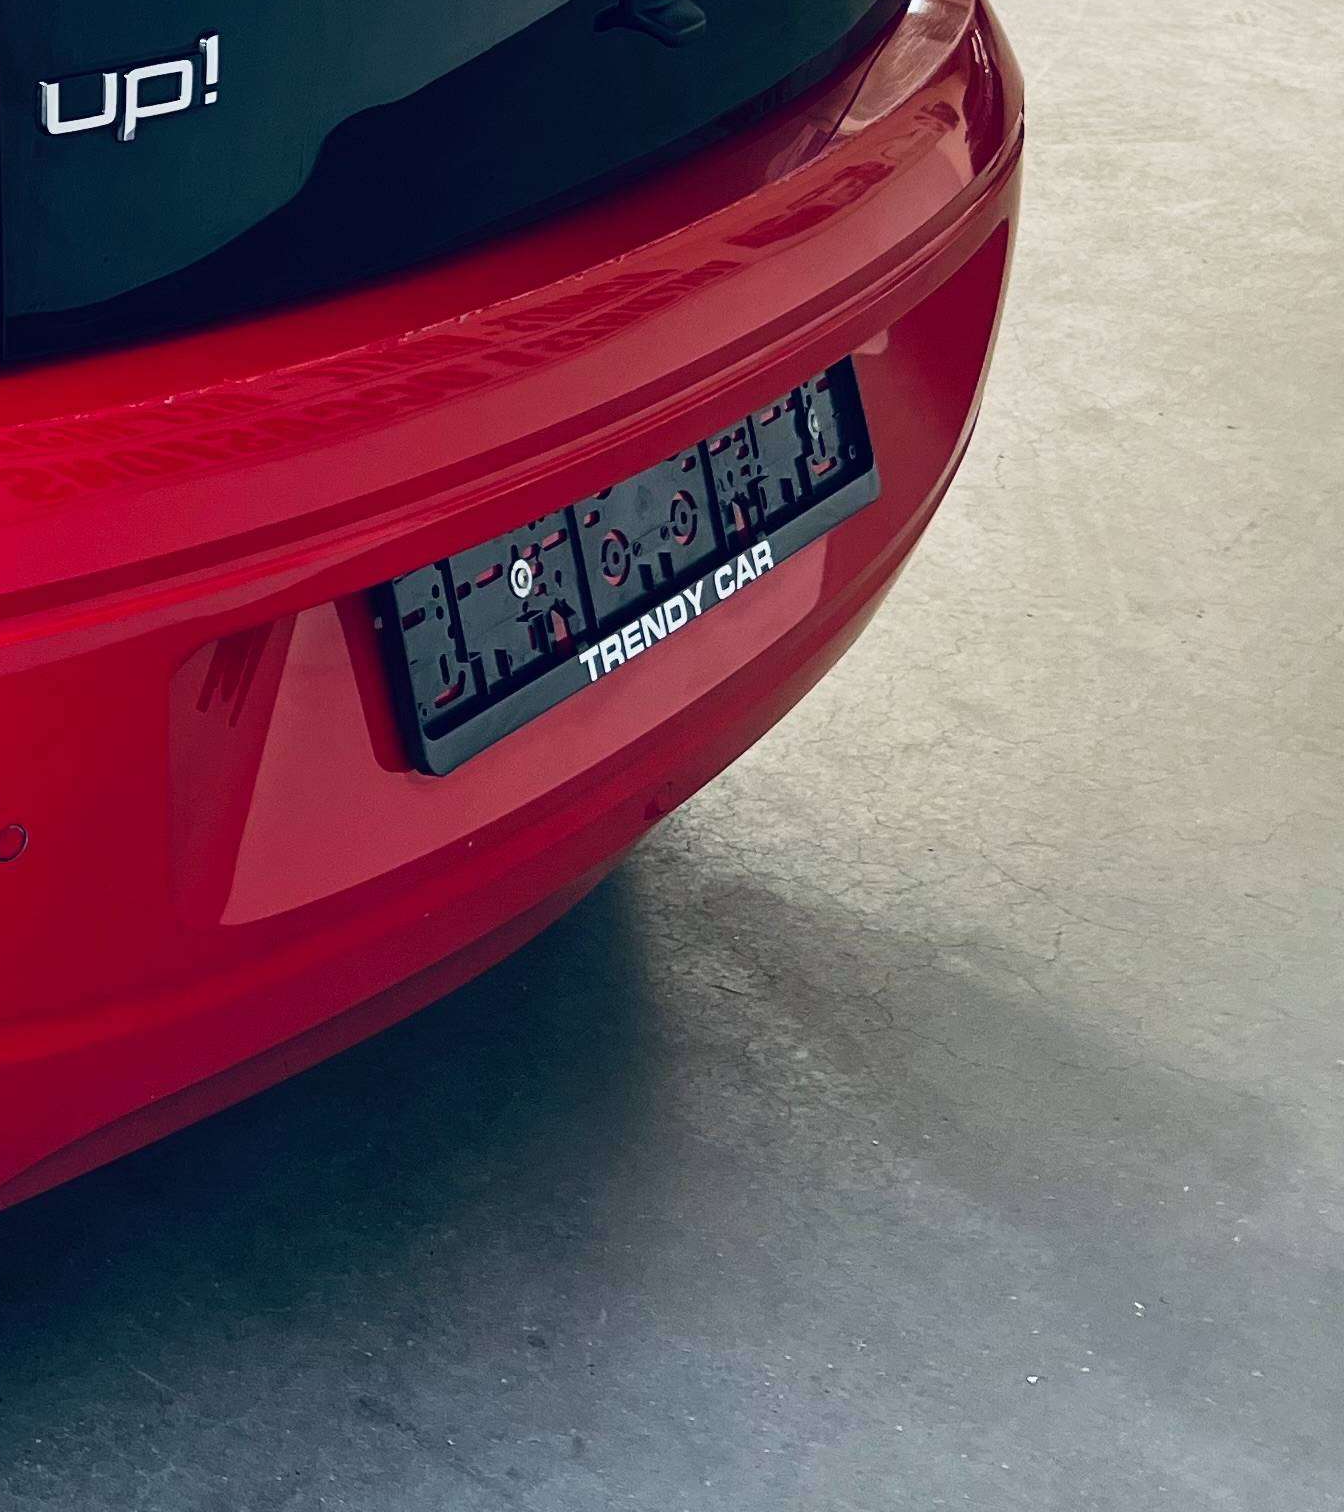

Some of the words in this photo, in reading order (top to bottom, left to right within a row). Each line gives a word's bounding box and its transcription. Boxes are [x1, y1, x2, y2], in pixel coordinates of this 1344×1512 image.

[39, 34, 220, 141] up!
[579, 580, 703, 681] TRENDY
[714, 540, 774, 600] CAR
